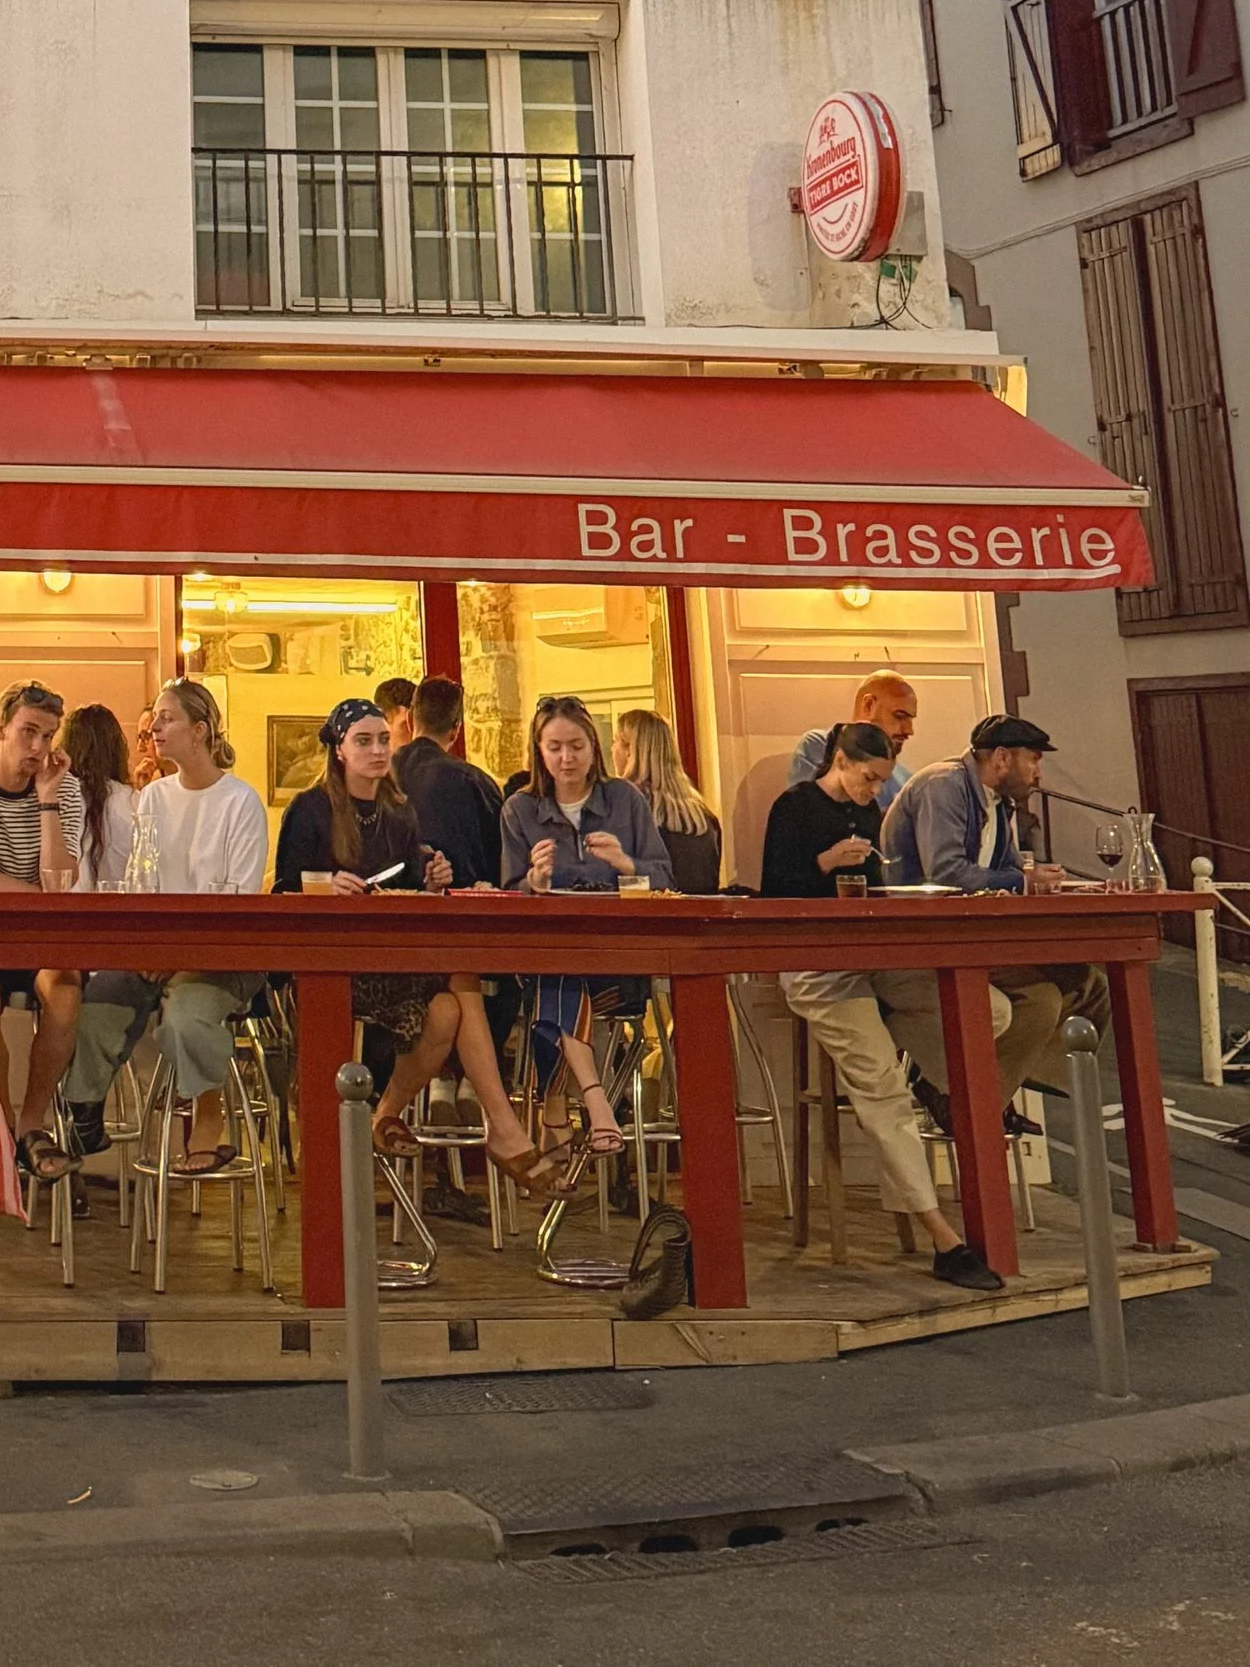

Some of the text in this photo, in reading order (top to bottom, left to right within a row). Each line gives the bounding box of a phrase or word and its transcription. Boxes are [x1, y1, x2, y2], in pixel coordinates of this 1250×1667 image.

[809, 166, 859, 206] TIGRE BOCK
[577, 502, 693, 559] Bar
[782, 508, 1116, 567] Brasserie
